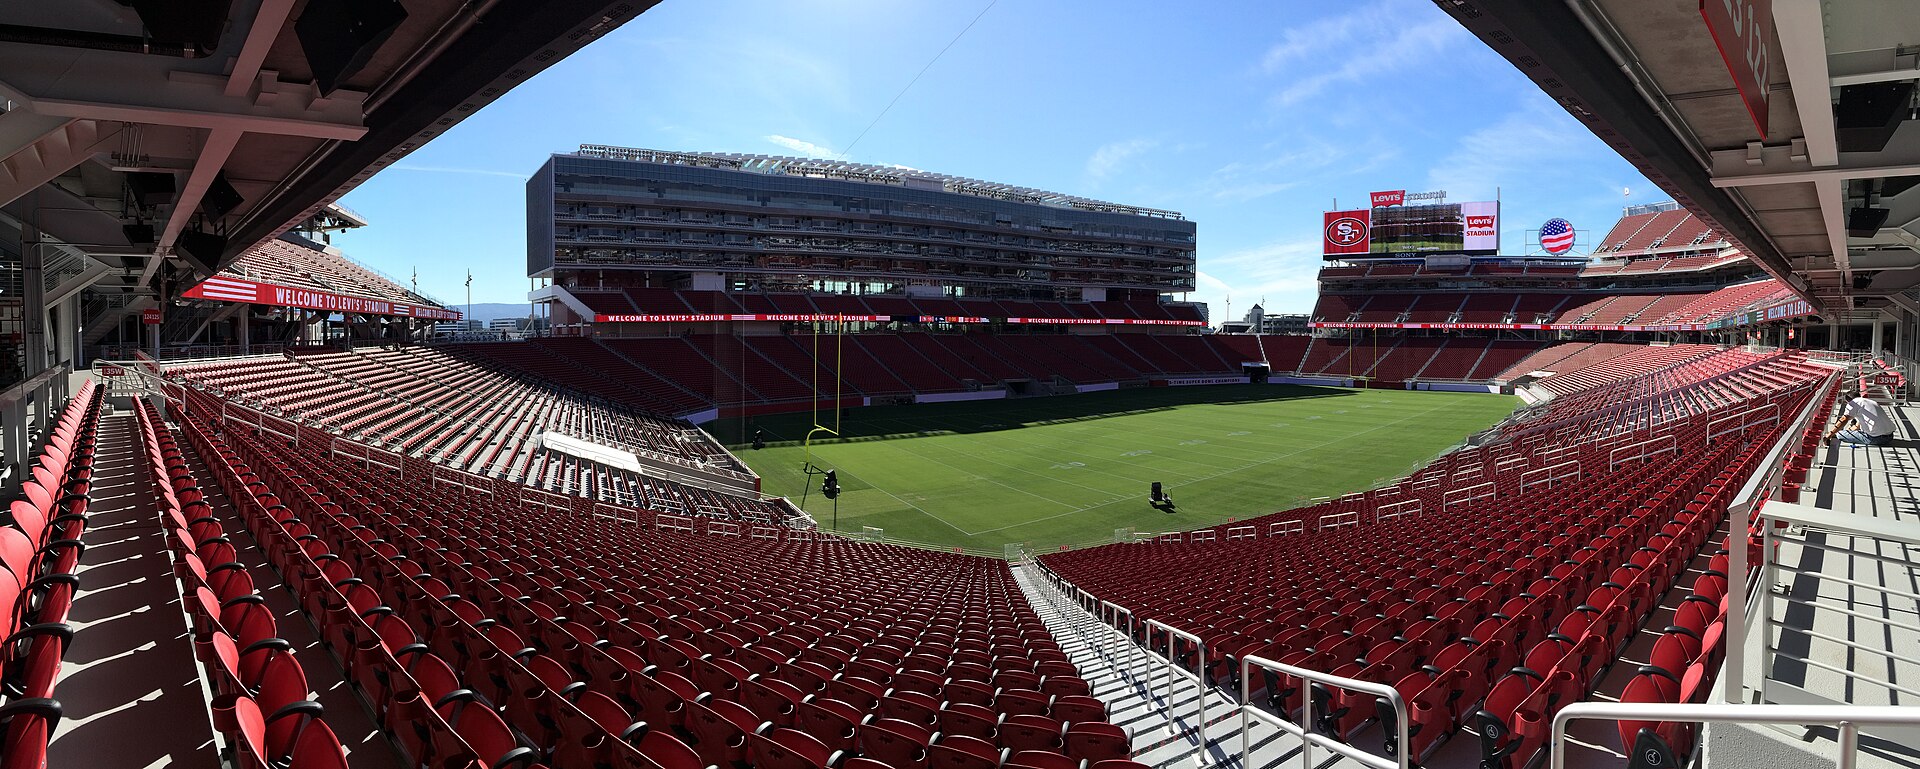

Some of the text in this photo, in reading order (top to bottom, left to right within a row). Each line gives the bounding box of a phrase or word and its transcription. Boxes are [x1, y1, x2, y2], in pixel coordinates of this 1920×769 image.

[1407, 190, 1447, 201] STADIUM
[276, 287, 323, 308] WELCOME
[326, 295, 336, 309] TO
[364, 300, 389, 313] STADIUM
[1767, 304, 1786, 319] WELCOME
[1787, 303, 1793, 315] TO
